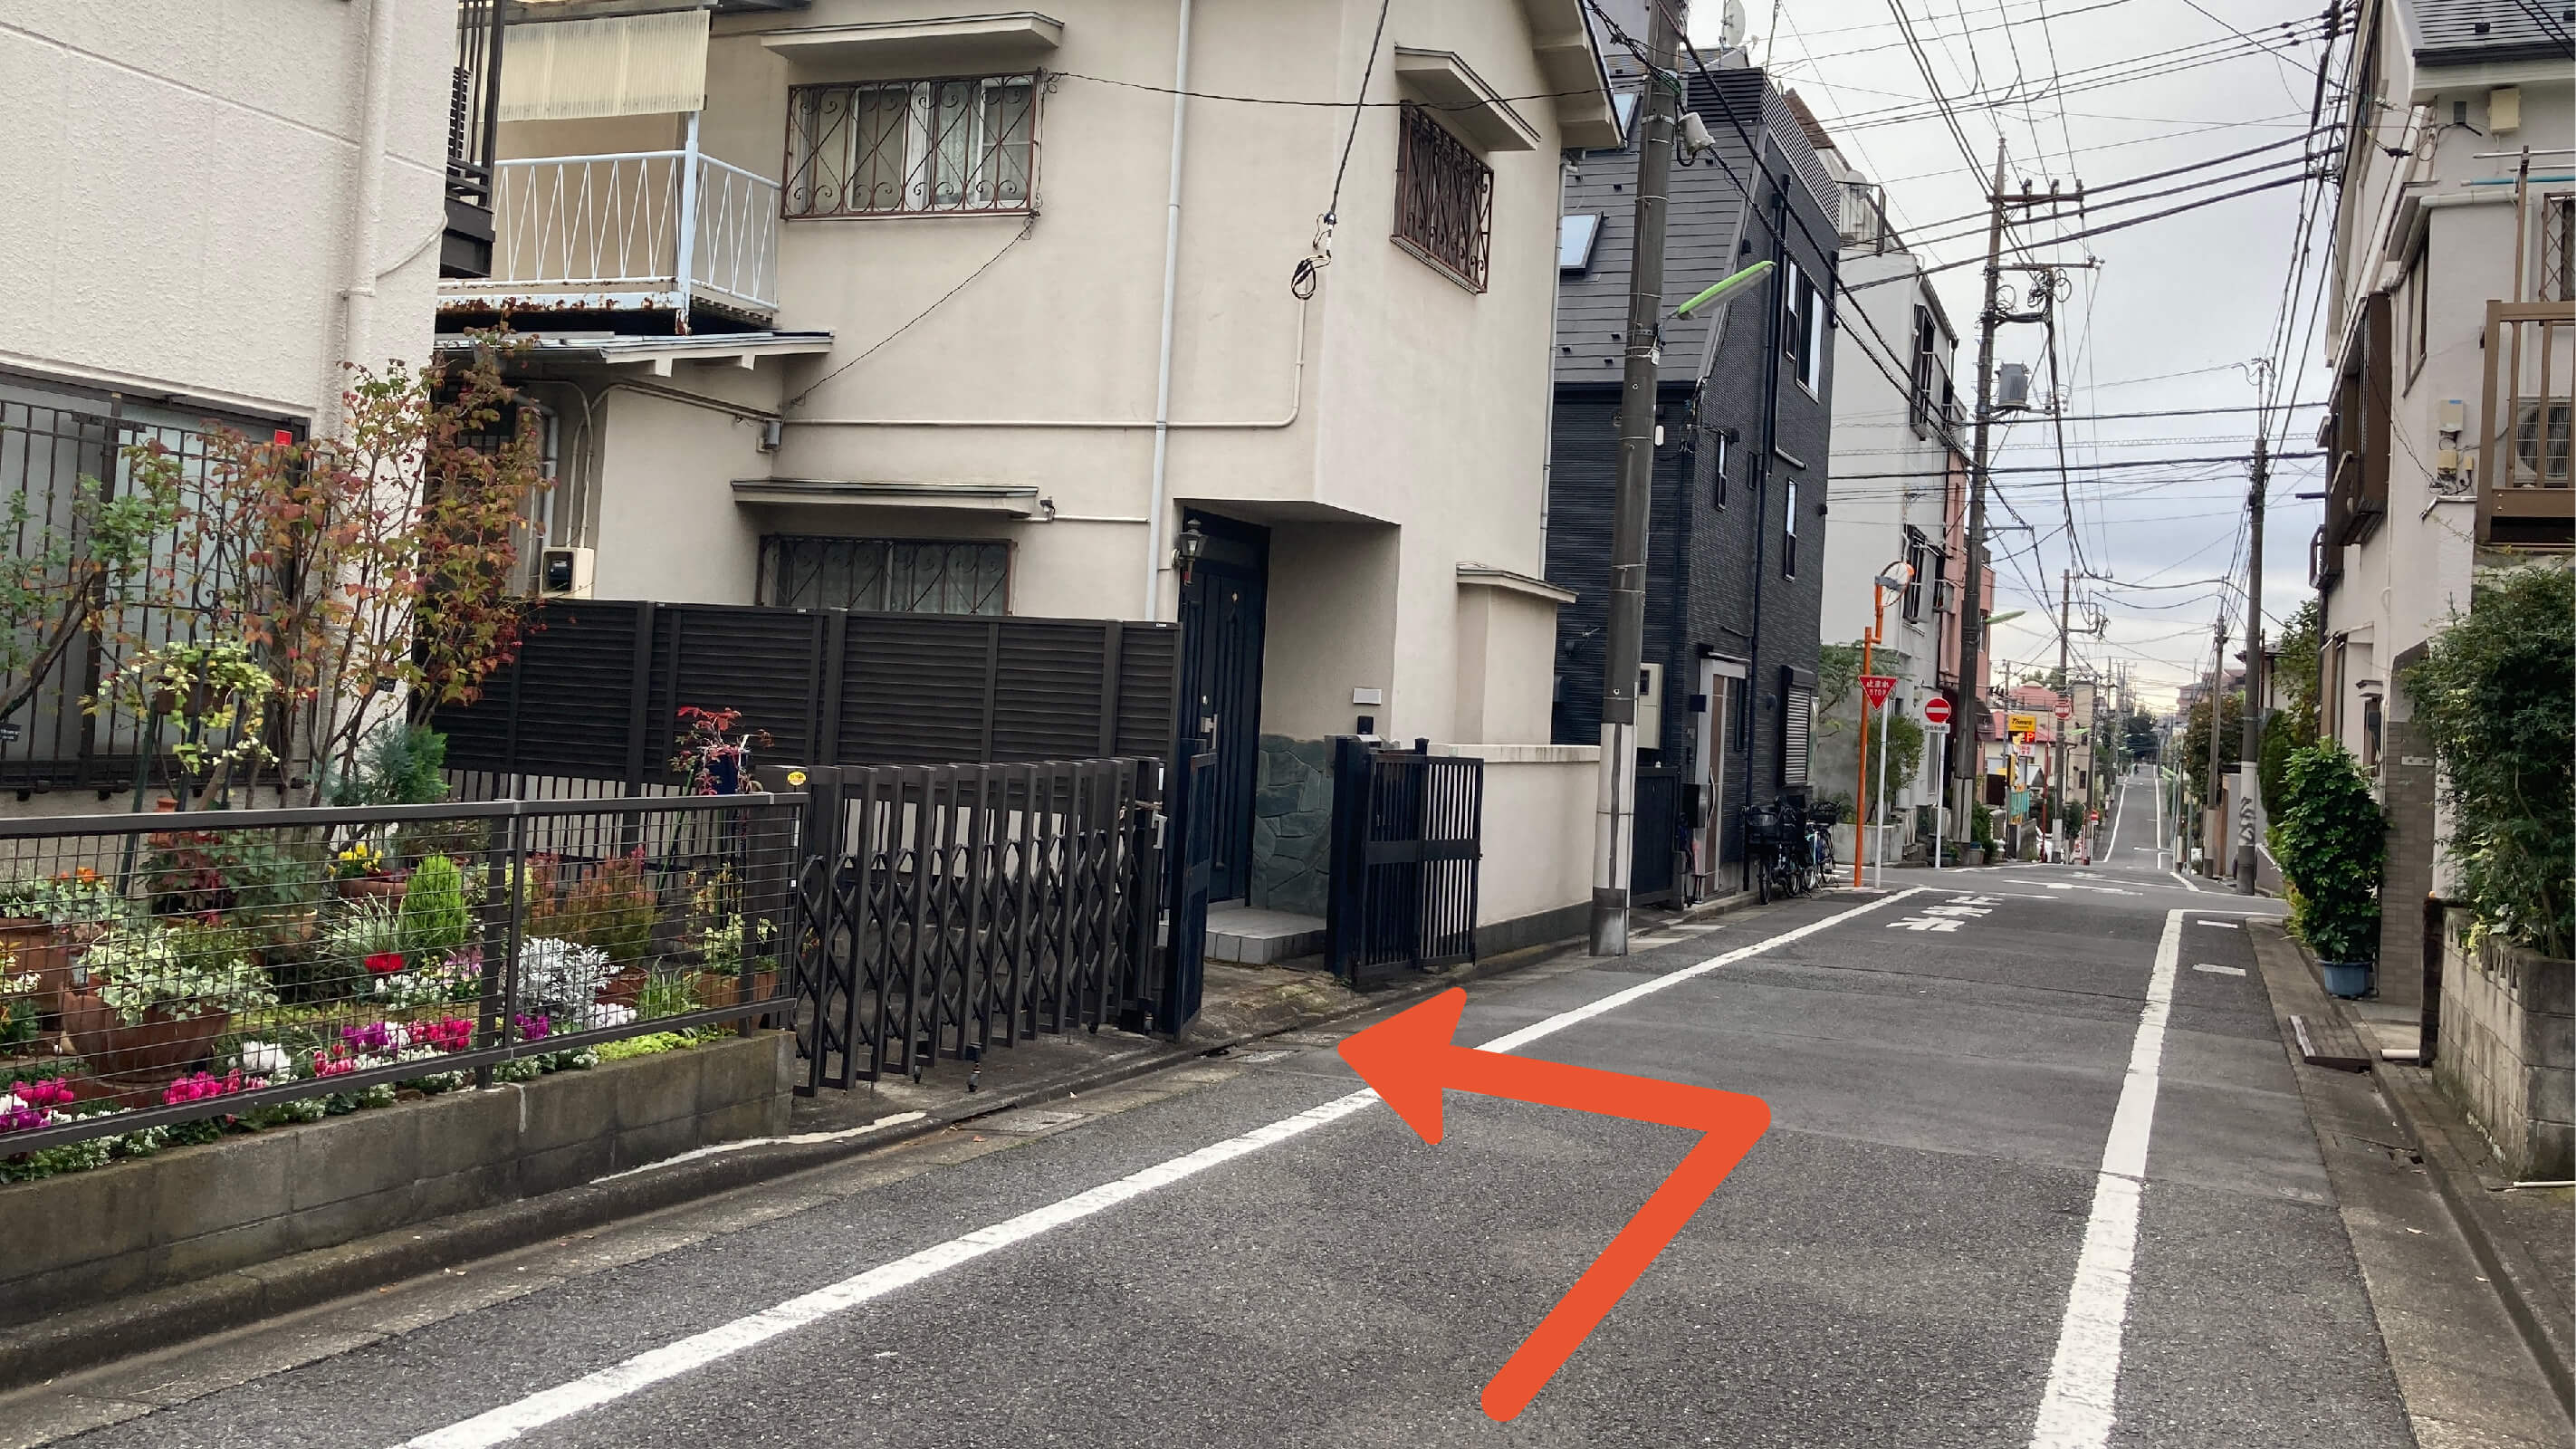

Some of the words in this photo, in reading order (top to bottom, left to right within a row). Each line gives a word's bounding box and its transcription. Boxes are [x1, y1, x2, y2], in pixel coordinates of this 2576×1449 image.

[1866, 679, 1890, 688] 止まれ
[2026, 732, 2035, 743] P
